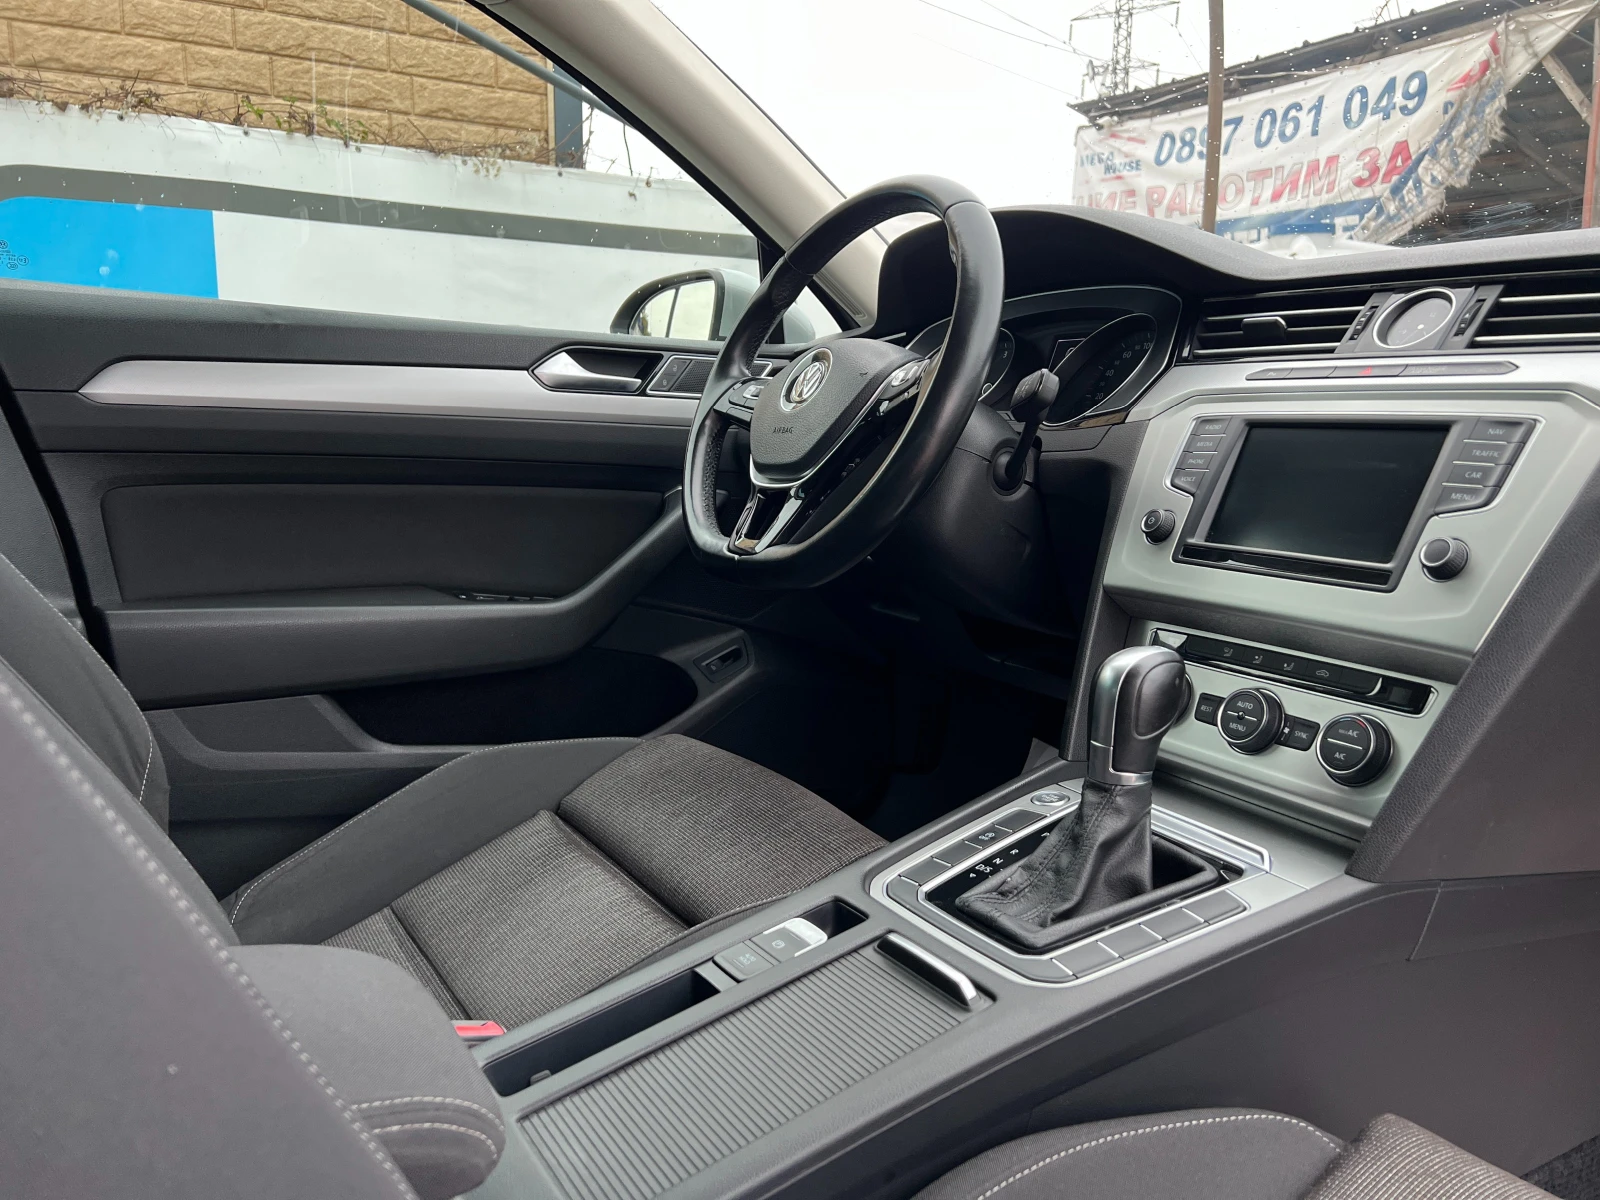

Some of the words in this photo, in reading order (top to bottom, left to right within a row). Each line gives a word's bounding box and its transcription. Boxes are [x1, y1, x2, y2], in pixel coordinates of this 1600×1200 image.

[1253, 95, 1325, 149] 061
[1342, 69, 1428, 130] 049
[1351, 139, 1413, 188] ЗА
[1471, 449, 1501, 458] TRAFFIC
[1464, 471, 1482, 479] CAR
[1450, 492, 1476, 501] MENU
[1200, 704, 1213, 713] REST
[1236, 700, 1254, 710] AUTO
[1229, 722, 1247, 732] MENU
[1294, 730, 1309, 740] SYNC
[1333, 751, 1346, 761] A/C
